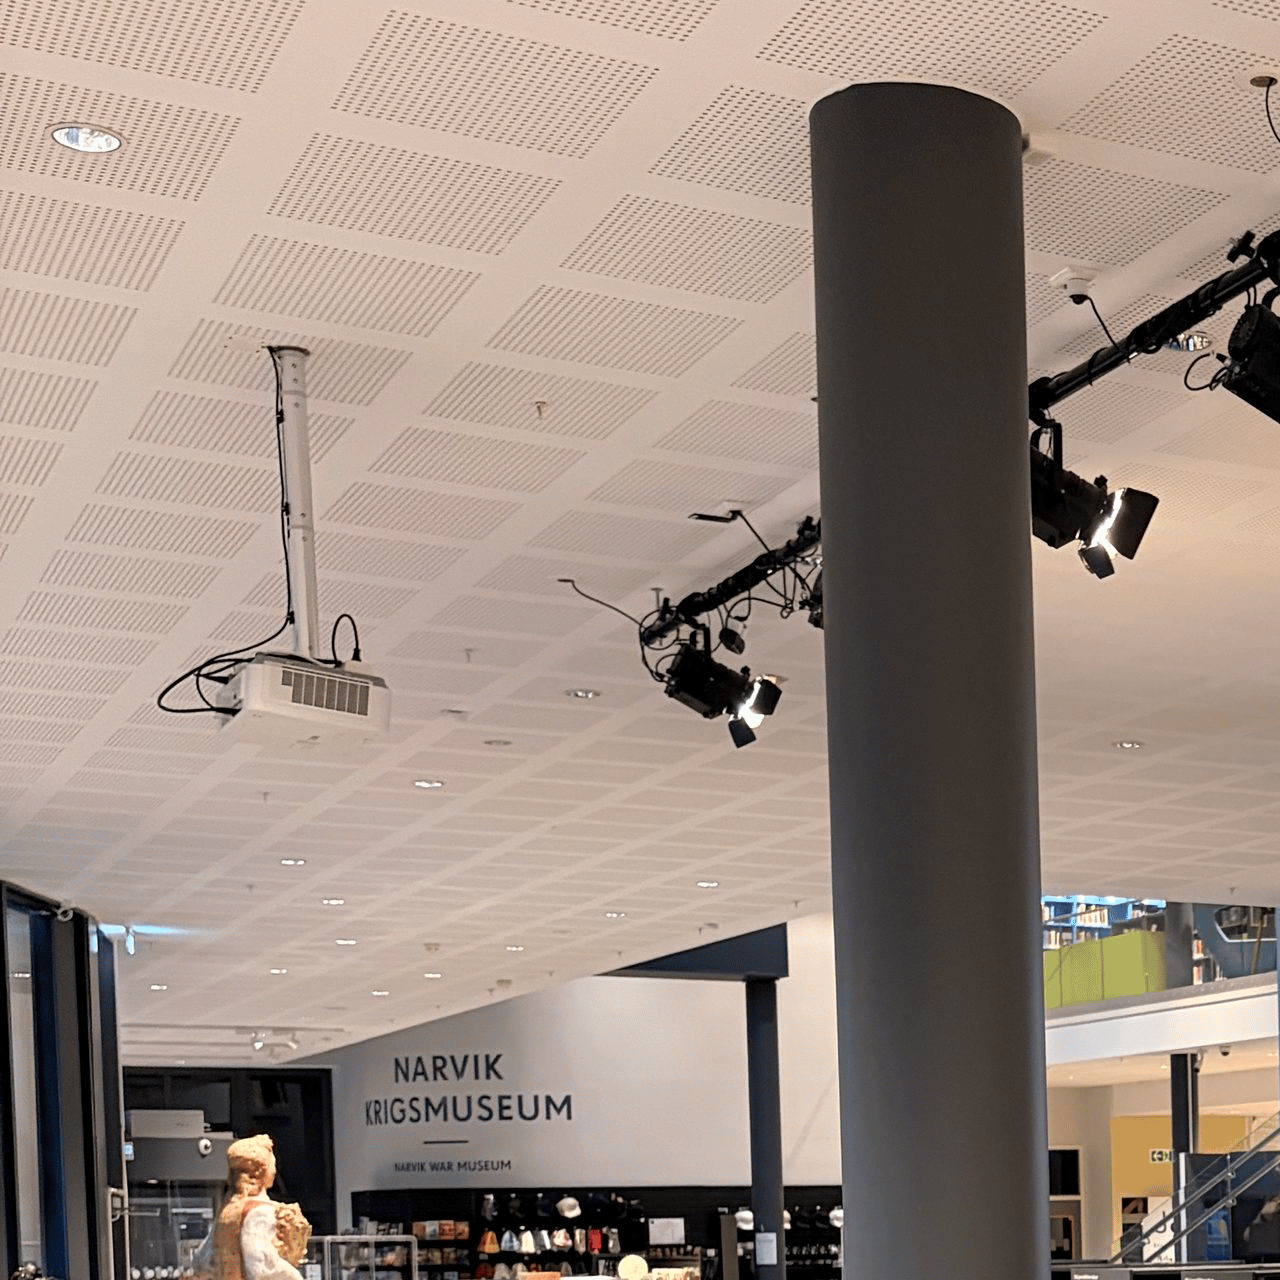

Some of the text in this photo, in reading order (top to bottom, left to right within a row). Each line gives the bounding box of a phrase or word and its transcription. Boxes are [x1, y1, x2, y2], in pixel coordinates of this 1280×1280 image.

[394, 1054, 504, 1083] NARVIK
[365, 1093, 572, 1126] KRIGSMUSEUM
[394, 1160, 511, 1172] NARVIK WAR MUSEUM
